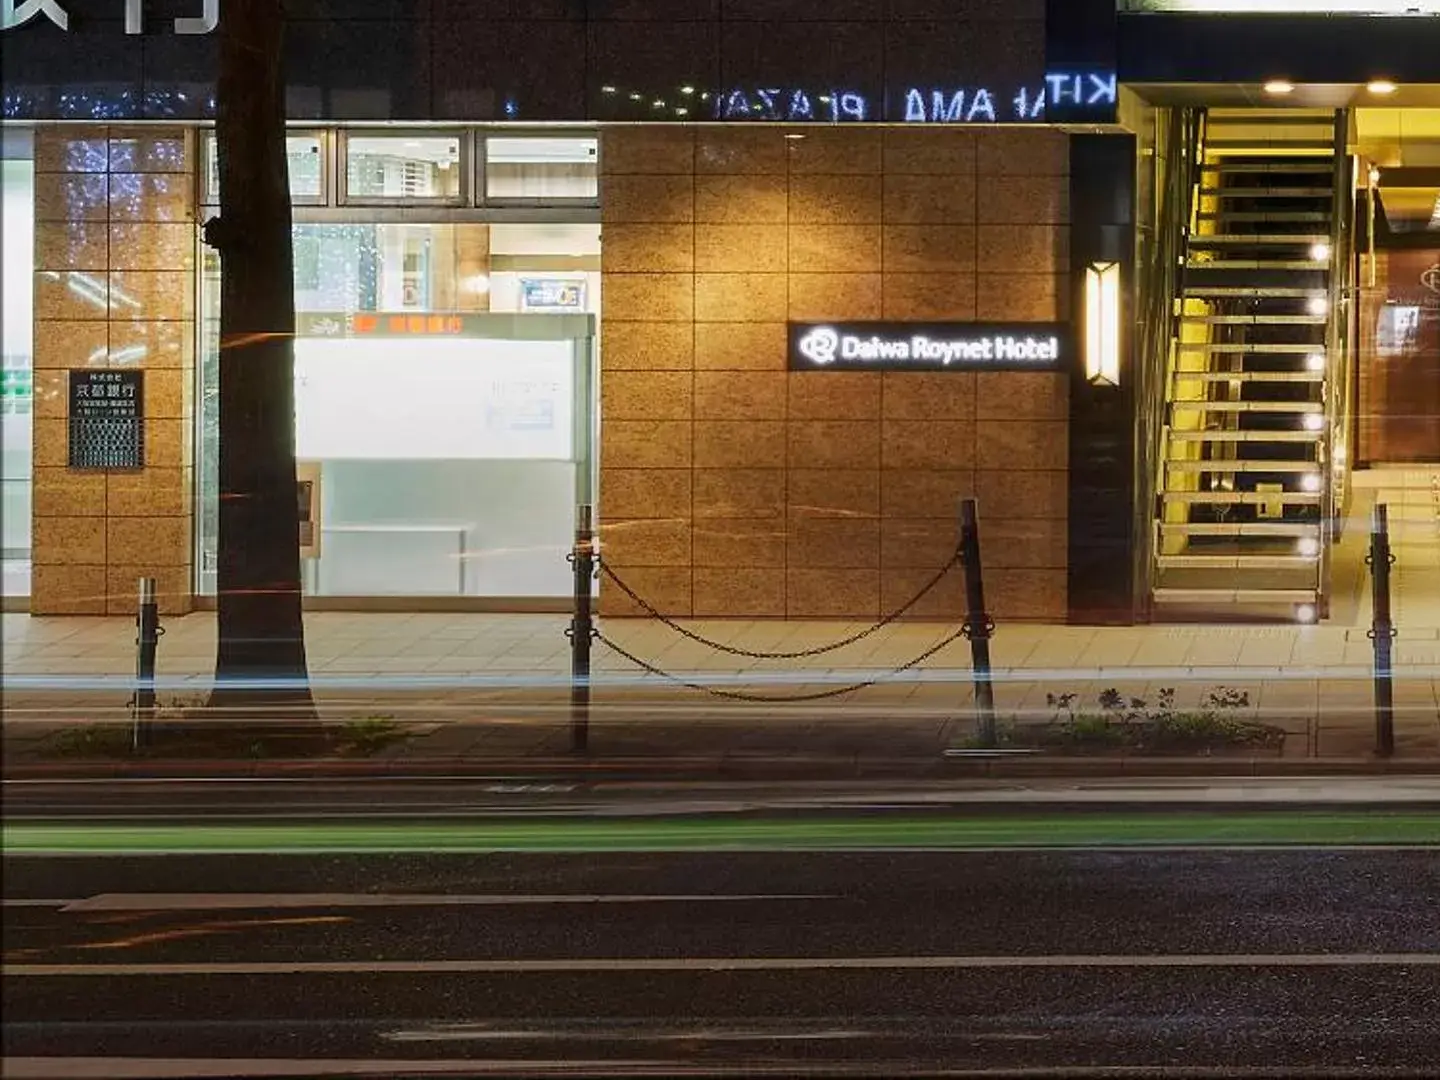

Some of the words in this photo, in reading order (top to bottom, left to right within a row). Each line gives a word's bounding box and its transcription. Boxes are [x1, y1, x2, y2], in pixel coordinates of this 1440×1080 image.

[840, 336, 909, 360] Daiwa
[911, 335, 992, 364] Roynet
[994, 336, 1059, 360] Hotel
